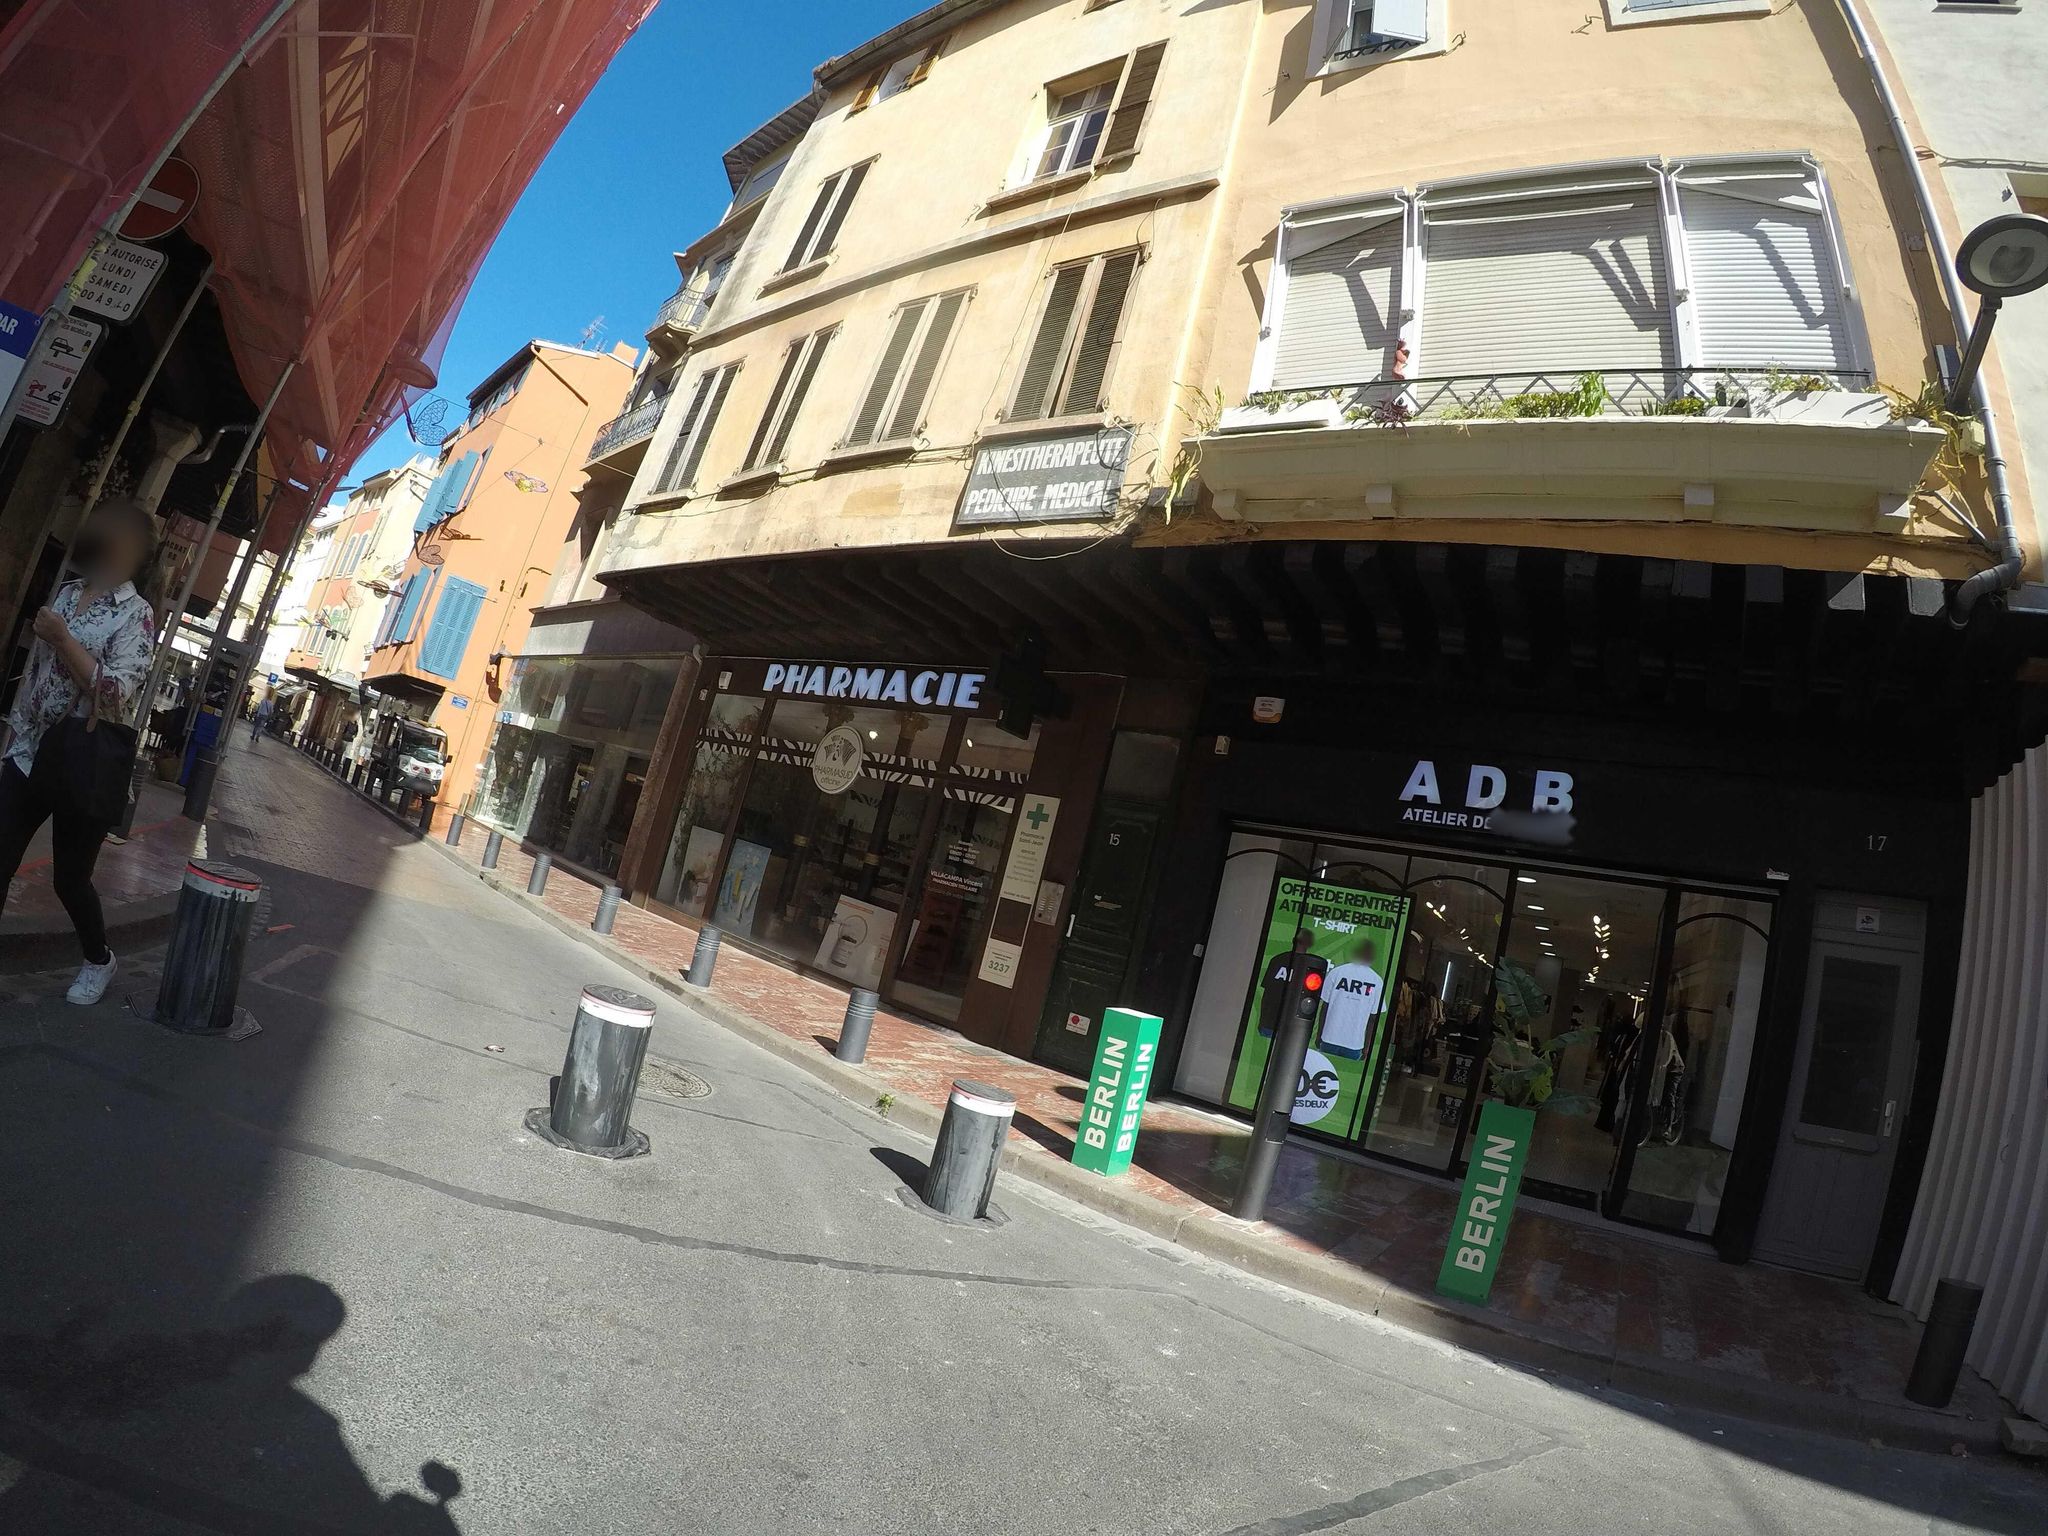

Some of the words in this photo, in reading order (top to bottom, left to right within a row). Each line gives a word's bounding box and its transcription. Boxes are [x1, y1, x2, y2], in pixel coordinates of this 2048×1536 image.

[102, 262, 136, 280] LUNDI
[89, 274, 132, 296] SAMEDI
[762, 663, 987, 709] PHARMACIE
[1402, 807, 1468, 827] ATELIER
[1109, 833, 1120, 846] 15
[1867, 835, 1887, 851] 17
[1325, 888, 1344, 904] DE
[1332, 906, 1351, 923] DE
[1313, 917, 1357, 935] T-SHIRT
[988, 960, 1010, 974] 3237
[1336, 977, 1376, 997] ART
[1084, 1036, 1128, 1150] BERLIN
[1116, 1043, 1154, 1153] BERLIN
[1305, 1100, 1329, 1109] DEUX
[1455, 1134, 1516, 1273] BERLIN
